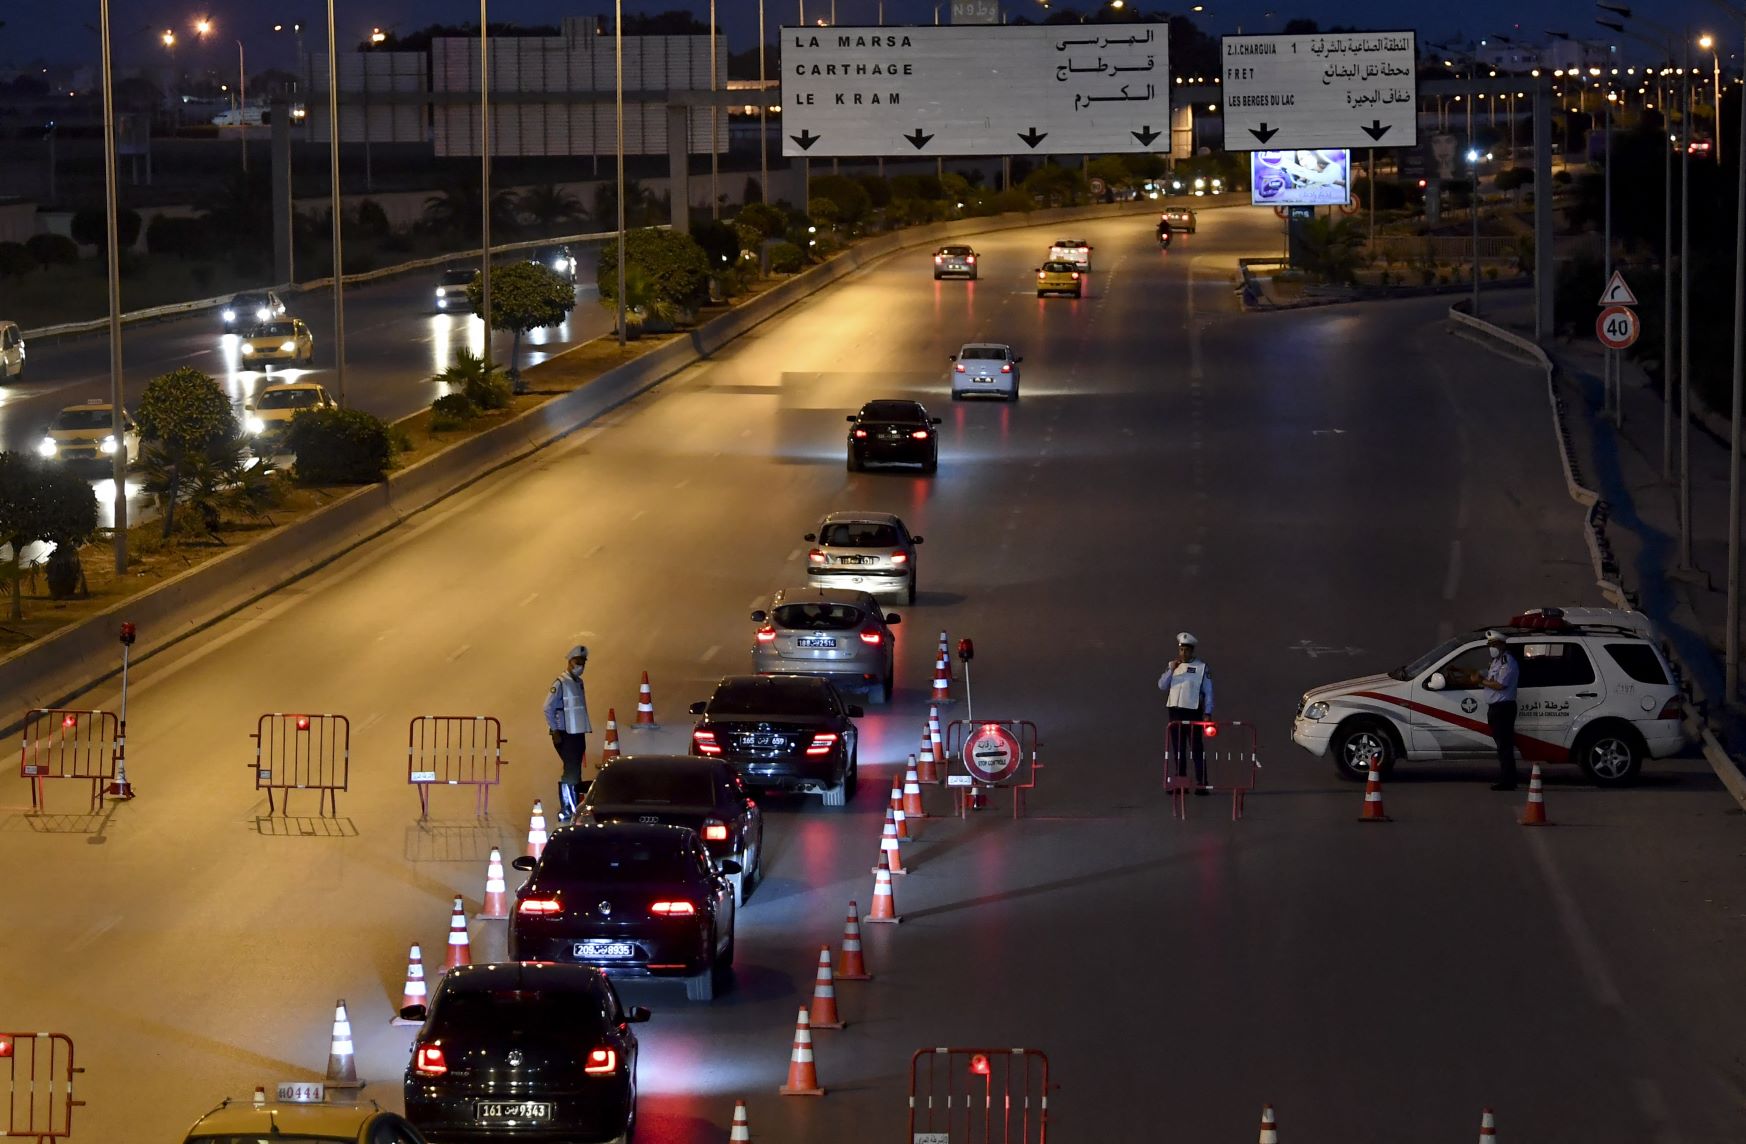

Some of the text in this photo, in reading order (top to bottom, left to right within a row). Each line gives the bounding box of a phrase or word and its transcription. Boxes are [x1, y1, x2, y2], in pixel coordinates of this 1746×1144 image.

[795, 35, 912, 47] LA MARSA
[1290, 42, 1297, 54] 1
[1348, 38, 1383, 56] الصناعية
[1384, 37, 1410, 51] المنطقة
[795, 64, 913, 76] CARTHAGE
[1056, 55, 1154, 81] قرطاج
[1227, 68, 1254, 80] FRET
[1361, 65, 1379, 81] نقل
[1380, 62, 1410, 76] محطة
[796, 93, 900, 105] LE KRAM
[1074, 83, 1155, 112] الكرم
[1228, 93, 1295, 107] LES BERGES DU LAC
[1346, 88, 1411, 109] ضفاف البحيرة
[1607, 318, 1628, 336] 40
[1520, 700, 1570, 711] شرطة المرور
[577, 945, 594, 955] 209
[607, 945, 630, 955] 8935
[483, 1104, 502, 1117] 161
[519, 1104, 545, 1118] 9343
